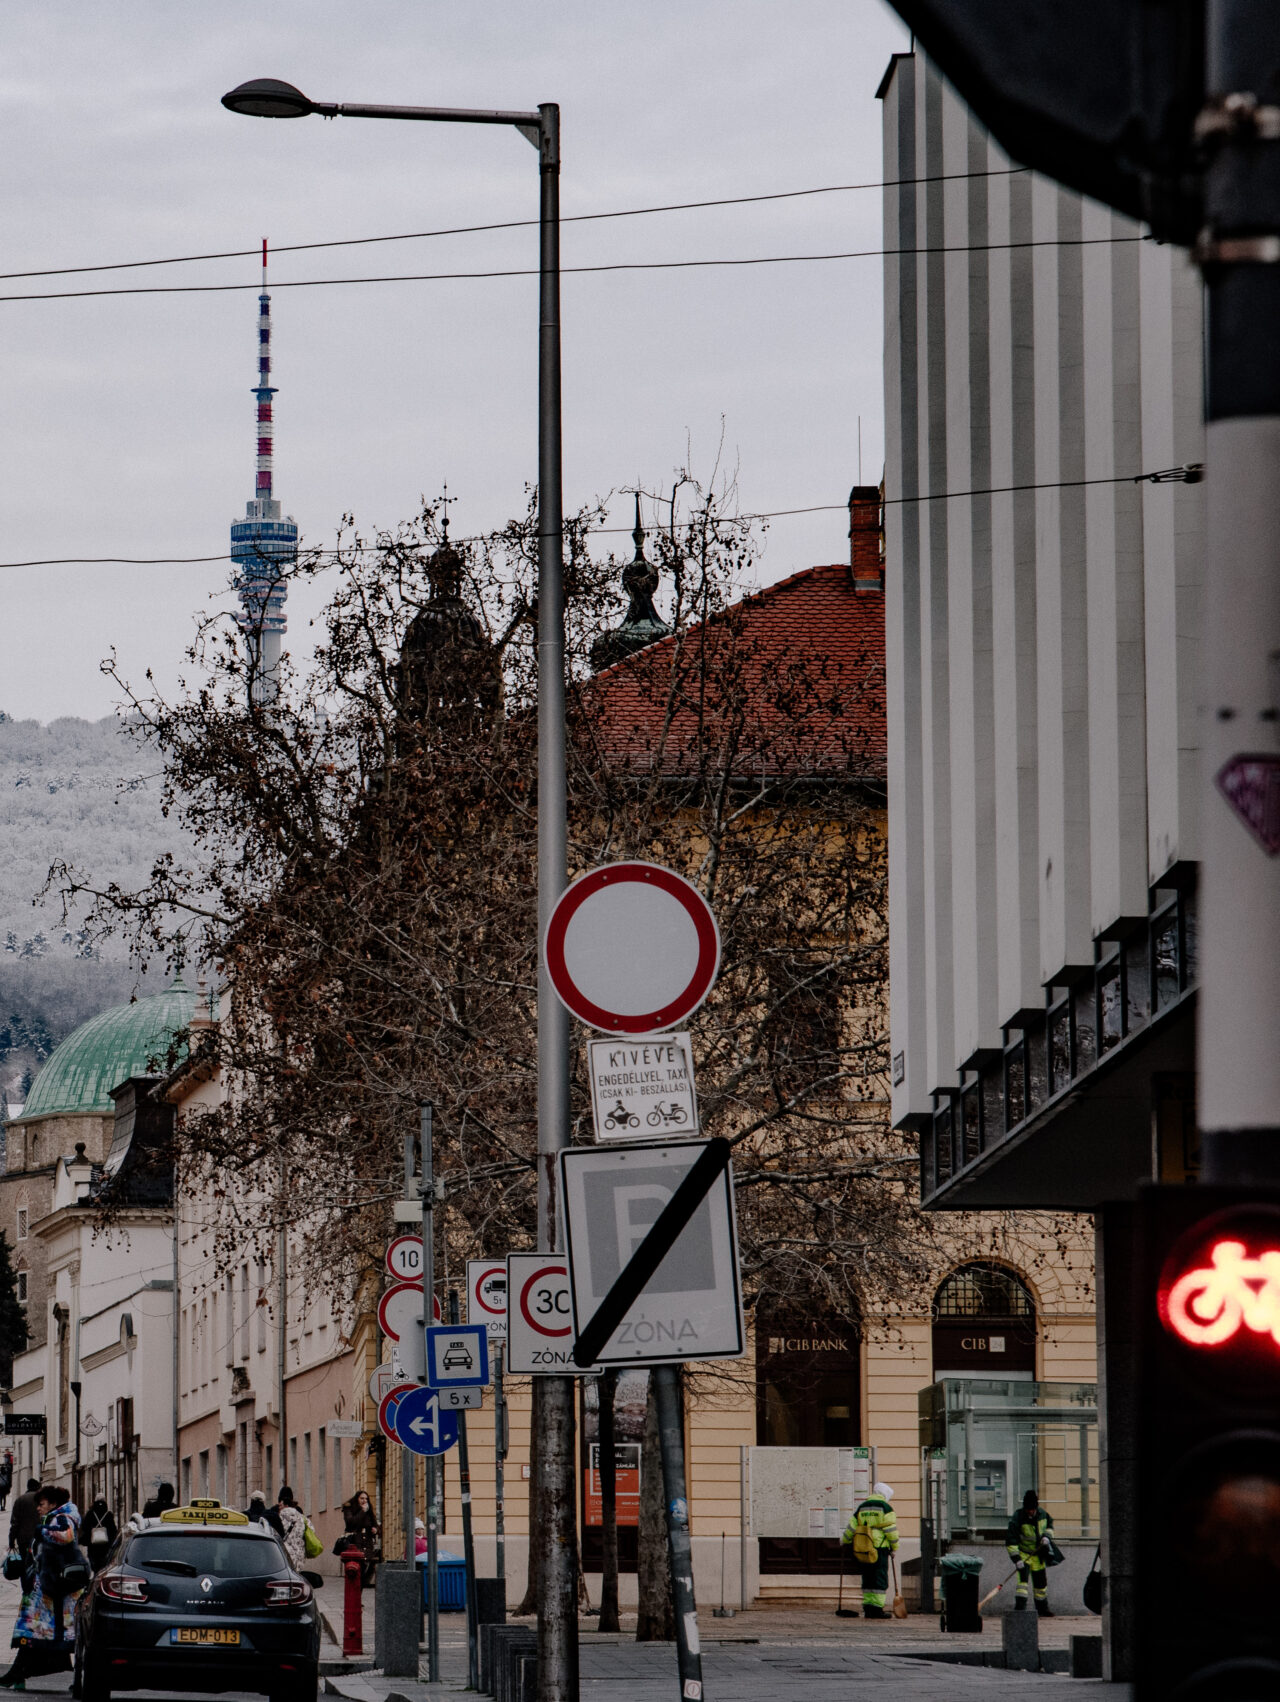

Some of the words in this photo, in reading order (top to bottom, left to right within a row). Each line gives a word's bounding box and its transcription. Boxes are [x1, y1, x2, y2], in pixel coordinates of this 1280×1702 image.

[609, 1046, 675, 1068] KIVÉVE
[667, 1068, 687, 1081] TAXI
[400, 1250, 419, 1268] 10
[536, 1289, 570, 1314] 30
[617, 1313, 699, 1345] ZÓNA
[786, 1338, 810, 1351] CIB
[811, 1338, 849, 1351] BANK
[960, 1338, 987, 1351] CIB
[450, 1392, 460, 1405] 5
[463, 1395, 470, 1405] x
[180, 1629, 238, 1642] EDM-013
